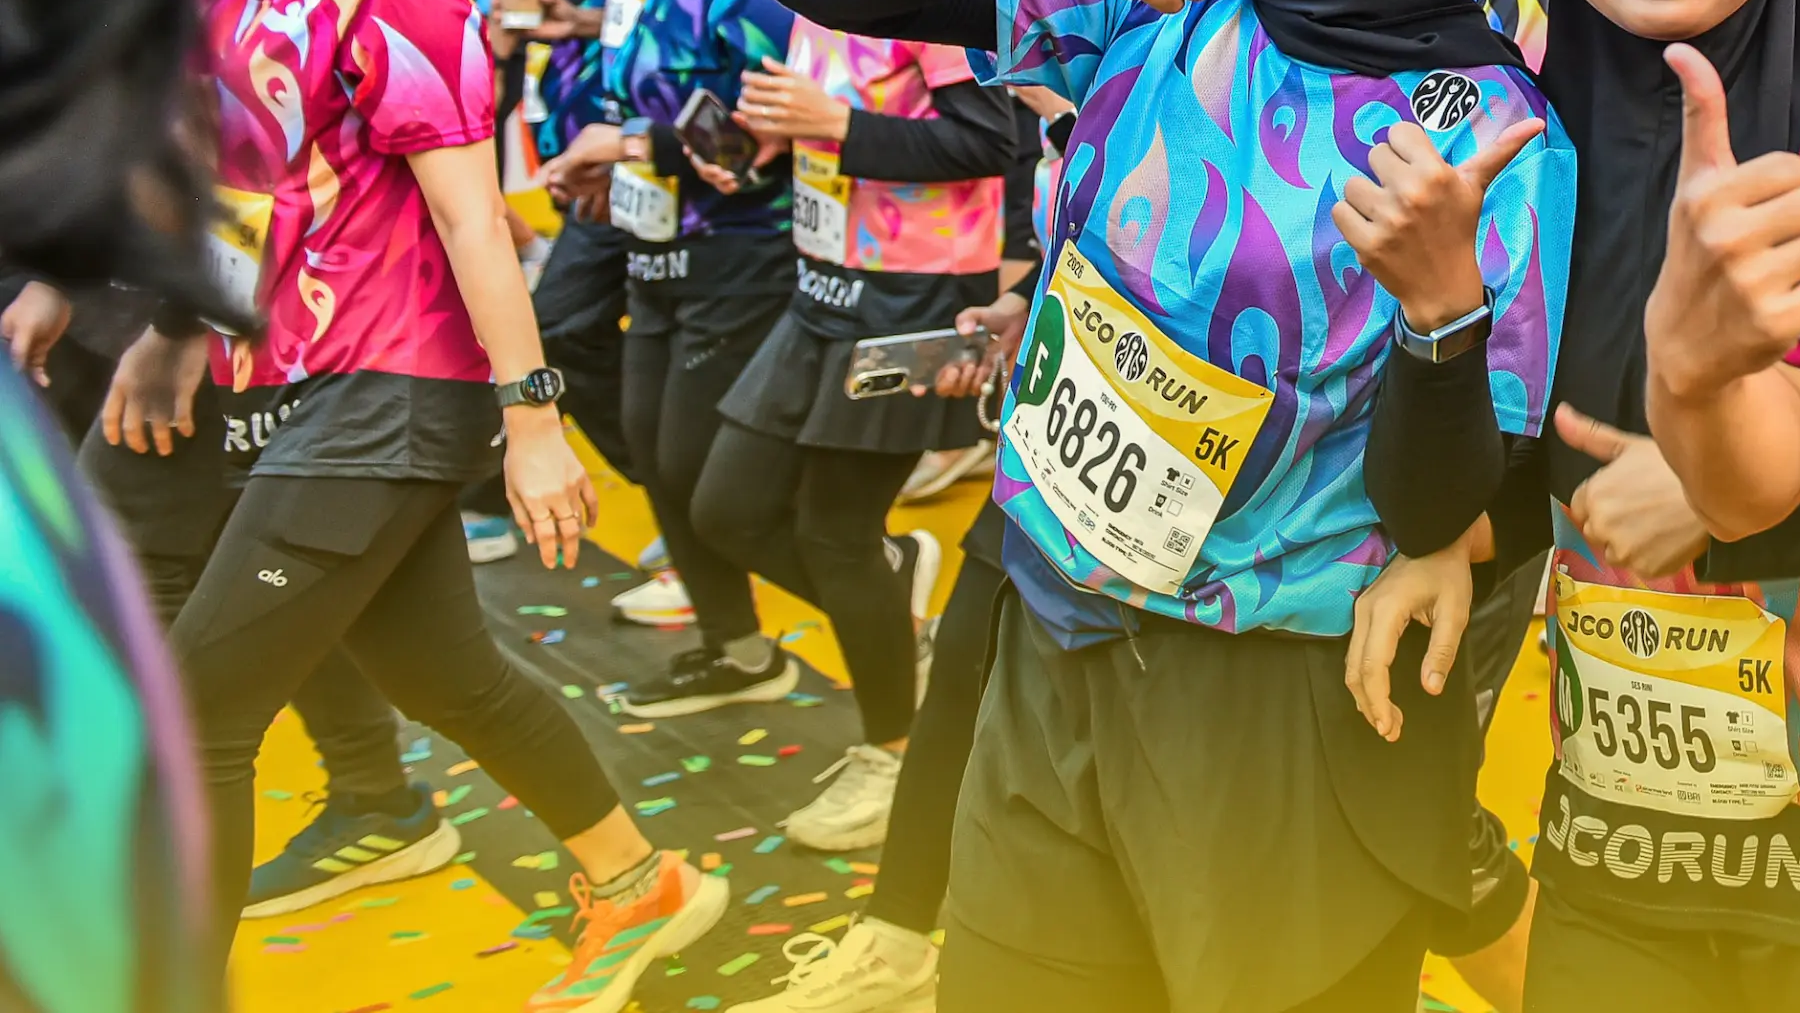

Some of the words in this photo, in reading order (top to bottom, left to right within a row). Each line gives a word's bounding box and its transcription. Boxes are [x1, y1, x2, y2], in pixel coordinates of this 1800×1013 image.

[1029, 341, 1049, 395] F
[1073, 299, 1116, 344] JCO
[1145, 367, 1209, 415] RUN
[1045, 377, 1148, 515] 6826
[1194, 427, 1240, 471] 5K
[1567, 610, 1615, 640] JCO
[1664, 626, 1730, 653] RUN
[1737, 658, 1773, 695] 5K
[1588, 687, 1717, 775] 5355
